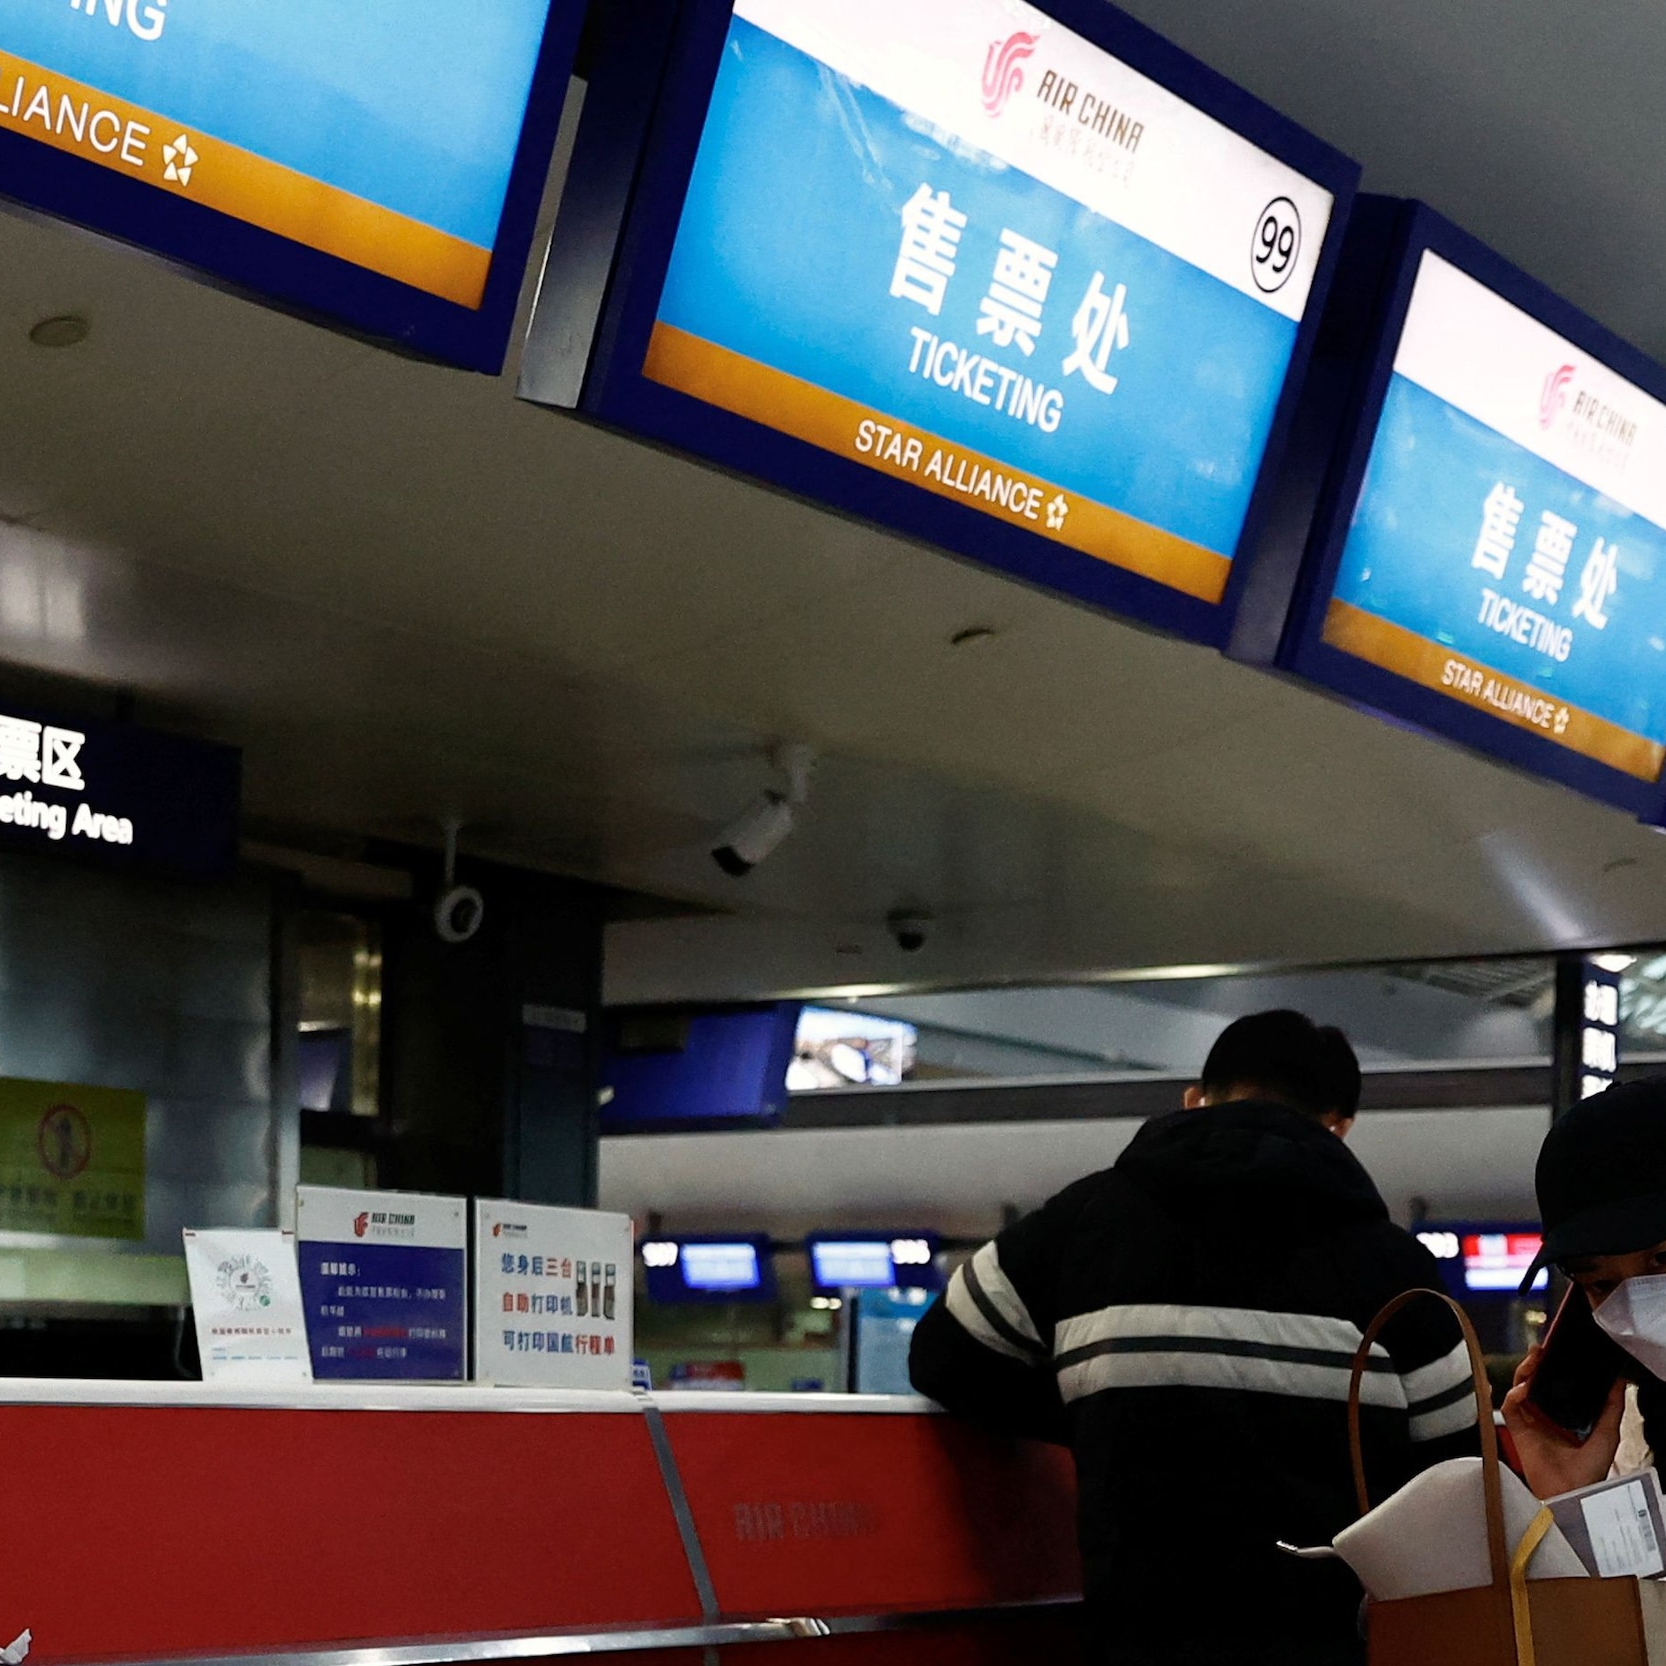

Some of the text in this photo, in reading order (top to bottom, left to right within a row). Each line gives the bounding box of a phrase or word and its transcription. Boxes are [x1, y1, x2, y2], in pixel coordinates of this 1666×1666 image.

[1036, 69, 1079, 115] AIR
[1078, 92, 1145, 154] CHINA
[1254, 215, 1295, 274] 99
[888, 183, 1130, 395] 售票处
[907, 327, 1063, 433] TICKETING
[1573, 390, 1637, 447] AIR CHINA
[855, 420, 1043, 521] STAR ALLIANCE
[1472, 481, 1620, 630] 售票处
[1478, 588, 1573, 662] TICKETING
[1442, 659, 1555, 729] STAR ALLIANCE
[72, 803, 133, 845] Area
[502, 1253, 572, 1279] 您身后三台
[502, 1292, 573, 1316] 自助打印机
[503, 1330, 615, 1356] 可打印国航行程单
